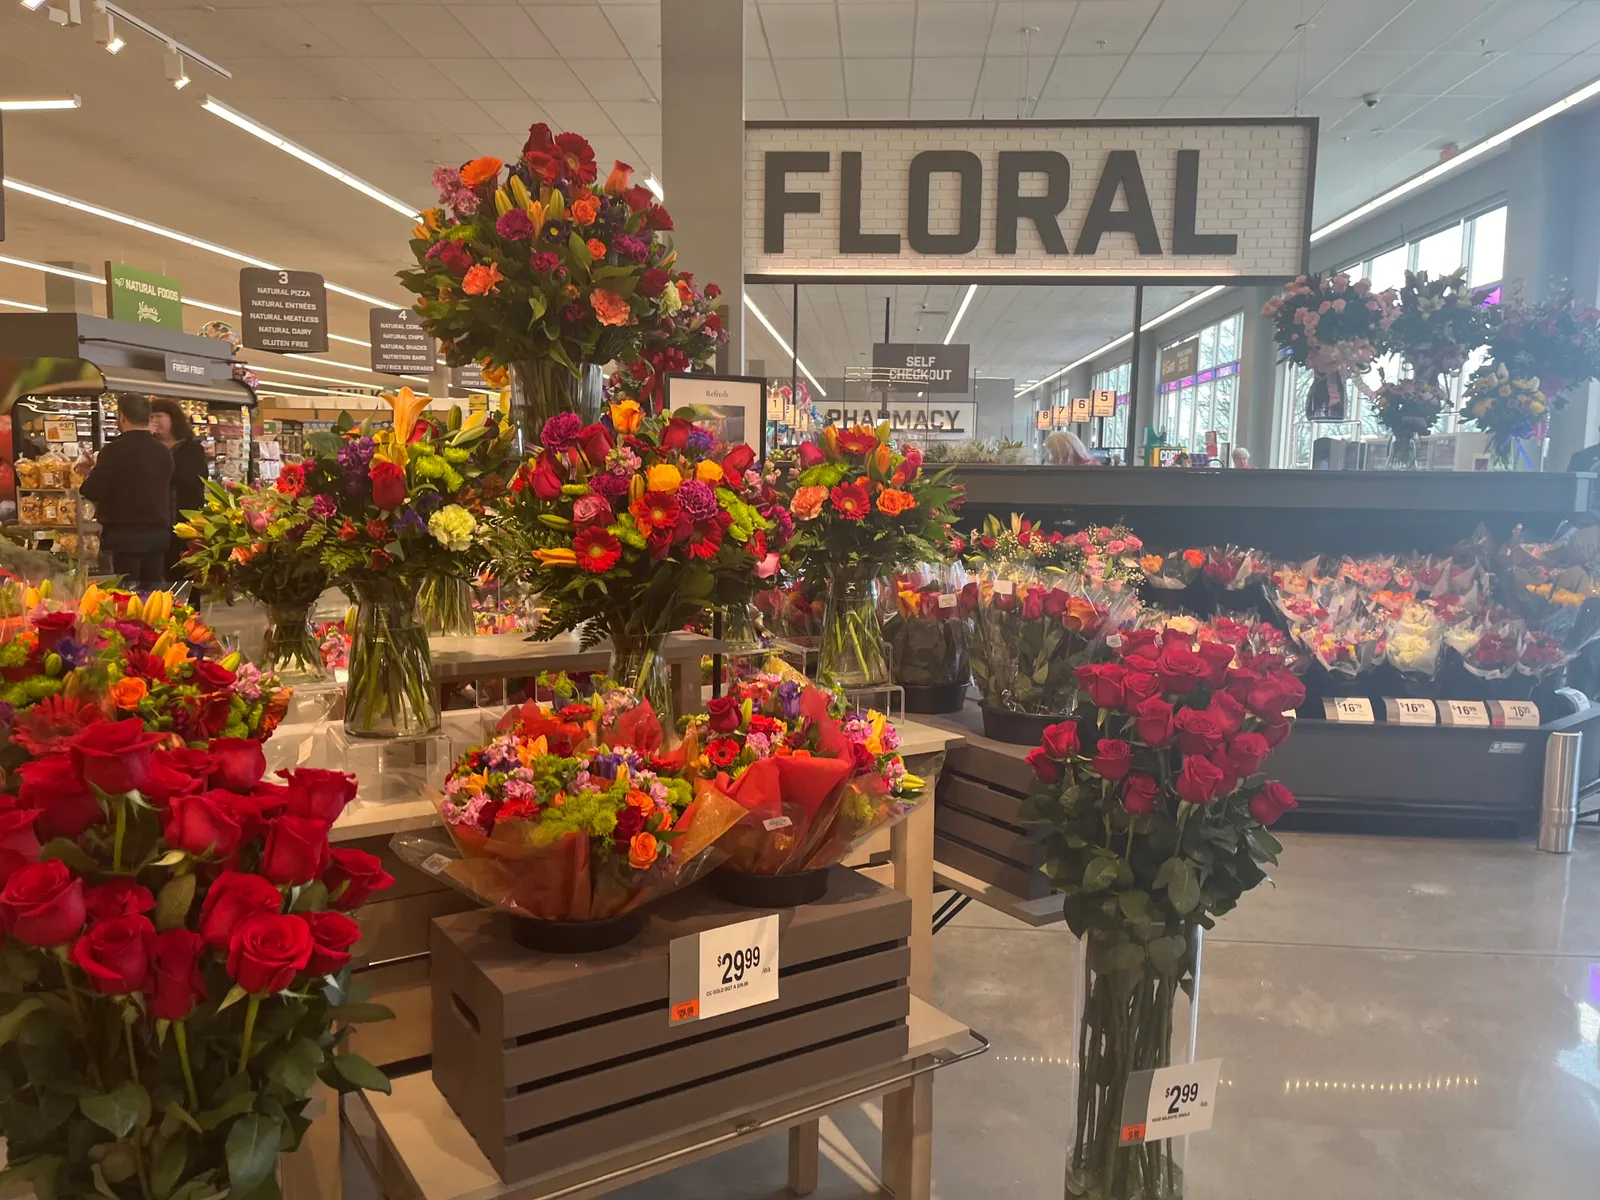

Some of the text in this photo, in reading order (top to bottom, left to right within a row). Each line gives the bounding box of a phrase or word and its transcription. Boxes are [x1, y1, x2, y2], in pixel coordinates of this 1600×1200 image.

[764, 150, 1238, 255] FLORAL
[278, 271, 289, 285] 3
[125, 279, 179, 302] NATURAL FOODS
[257, 287, 311, 297] NATURAL PIZZA
[251, 300, 317, 311] NATURAL ENTRÉES
[249, 312, 320, 323] NATURAL MEATLESS
[398, 310, 407, 321] 4
[258, 326, 312, 336] NATURAL DAIRY
[262, 339, 290, 347] GLUTEN
[906, 356, 936, 367] SELF
[172, 363, 205, 376] FRESH FRUIT
[889, 369, 952, 381] CHECKOUT
[705, 390, 729, 398] Refresh
[1100, 391, 1109, 402] 5
[773, 399, 777, 408] 1
[1078, 400, 1086, 409] 6
[1042, 411, 1049, 420] 8
[1059, 406, 1065, 415] 7
[712, 987, 725, 996] GOLD
